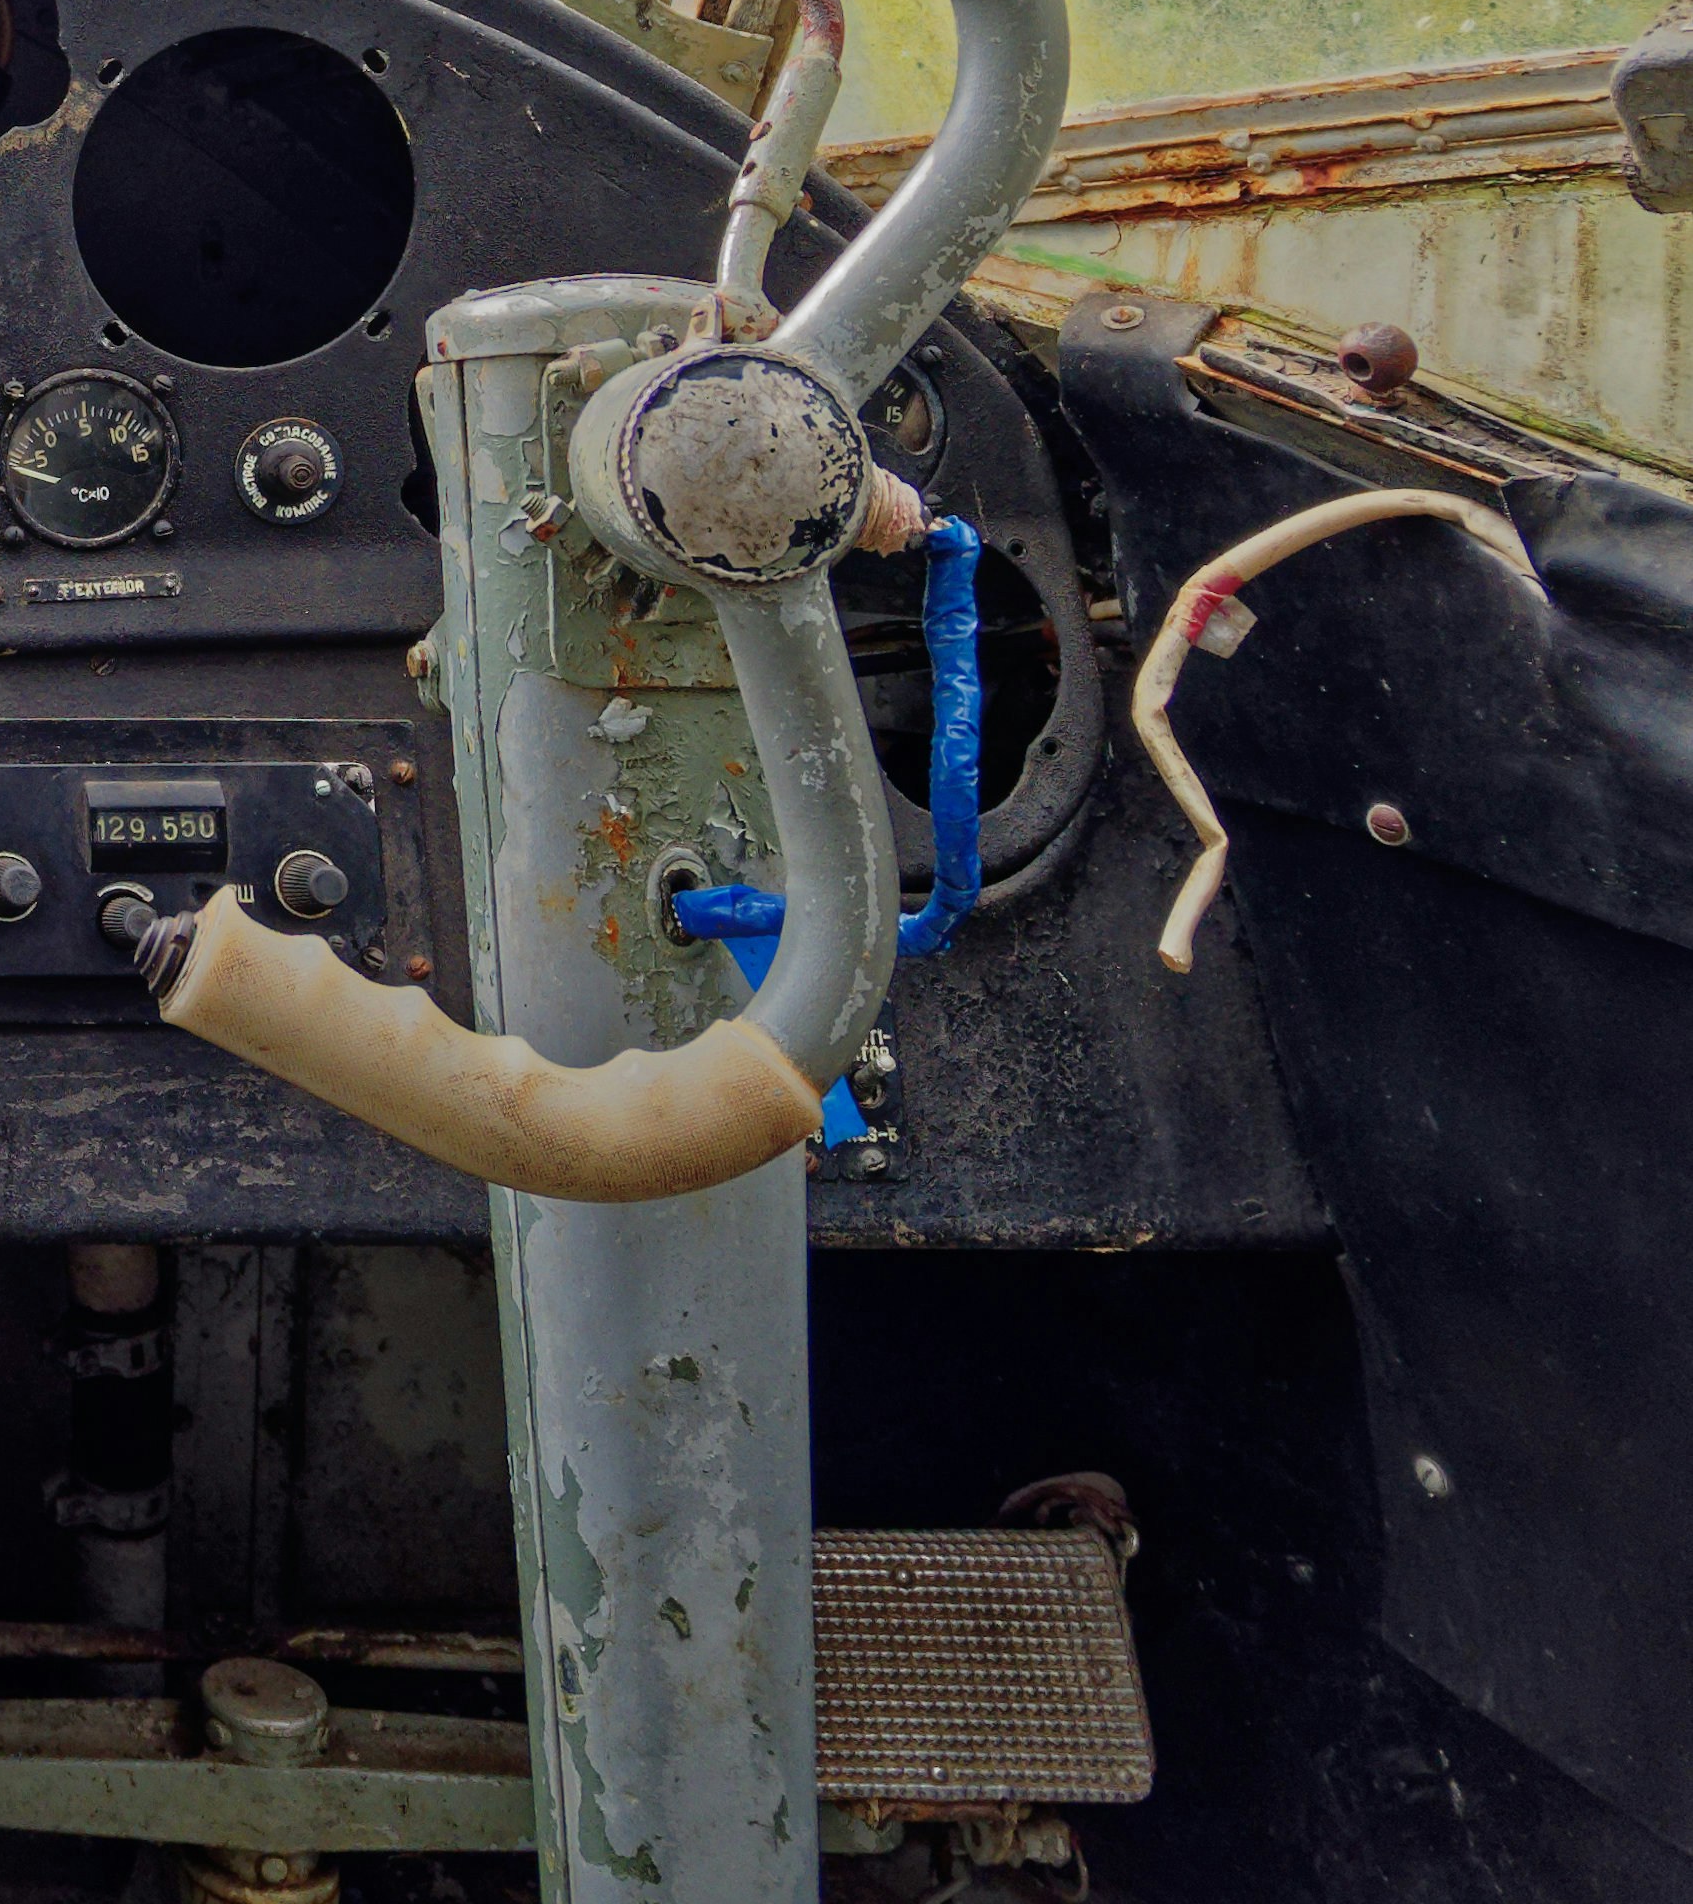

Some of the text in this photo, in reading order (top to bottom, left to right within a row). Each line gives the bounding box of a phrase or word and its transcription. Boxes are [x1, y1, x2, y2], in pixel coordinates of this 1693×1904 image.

[78, 418, 92, 437] 5
[110, 425, 127, 444] 10
[45, 431, 57, 448] 0
[131, 444, 149, 463] 15
[275, 490, 329, 518] КОМПАС
[96, 812, 216, 843] 129.550
